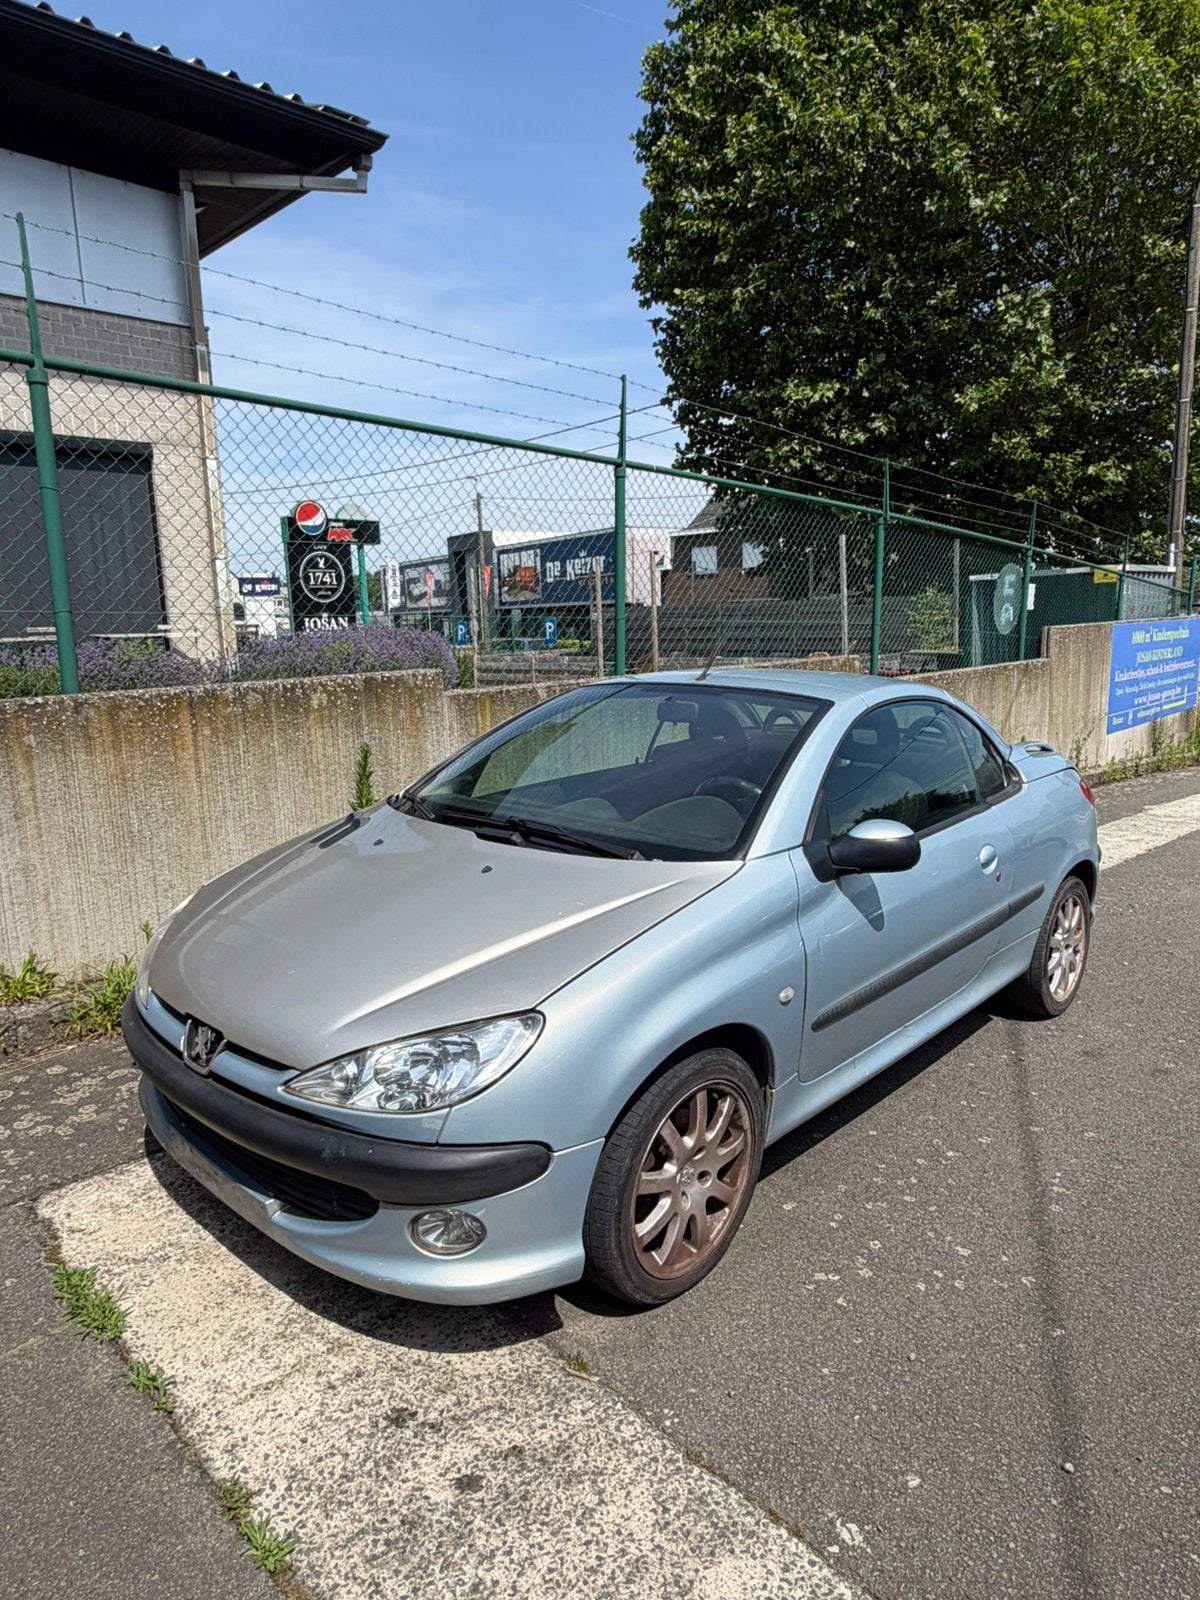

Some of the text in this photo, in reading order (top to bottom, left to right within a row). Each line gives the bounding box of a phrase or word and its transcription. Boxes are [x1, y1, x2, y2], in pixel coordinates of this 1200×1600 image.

[545, 561, 561, 583] De
[566, 556, 606, 581] Keizer
[308, 572, 338, 585] 1741
[303, 616, 349, 633] JOSAN
[457, 624, 466, 640] P
[545, 622, 555, 640] P
[1132, 630, 1145, 644] 1000
